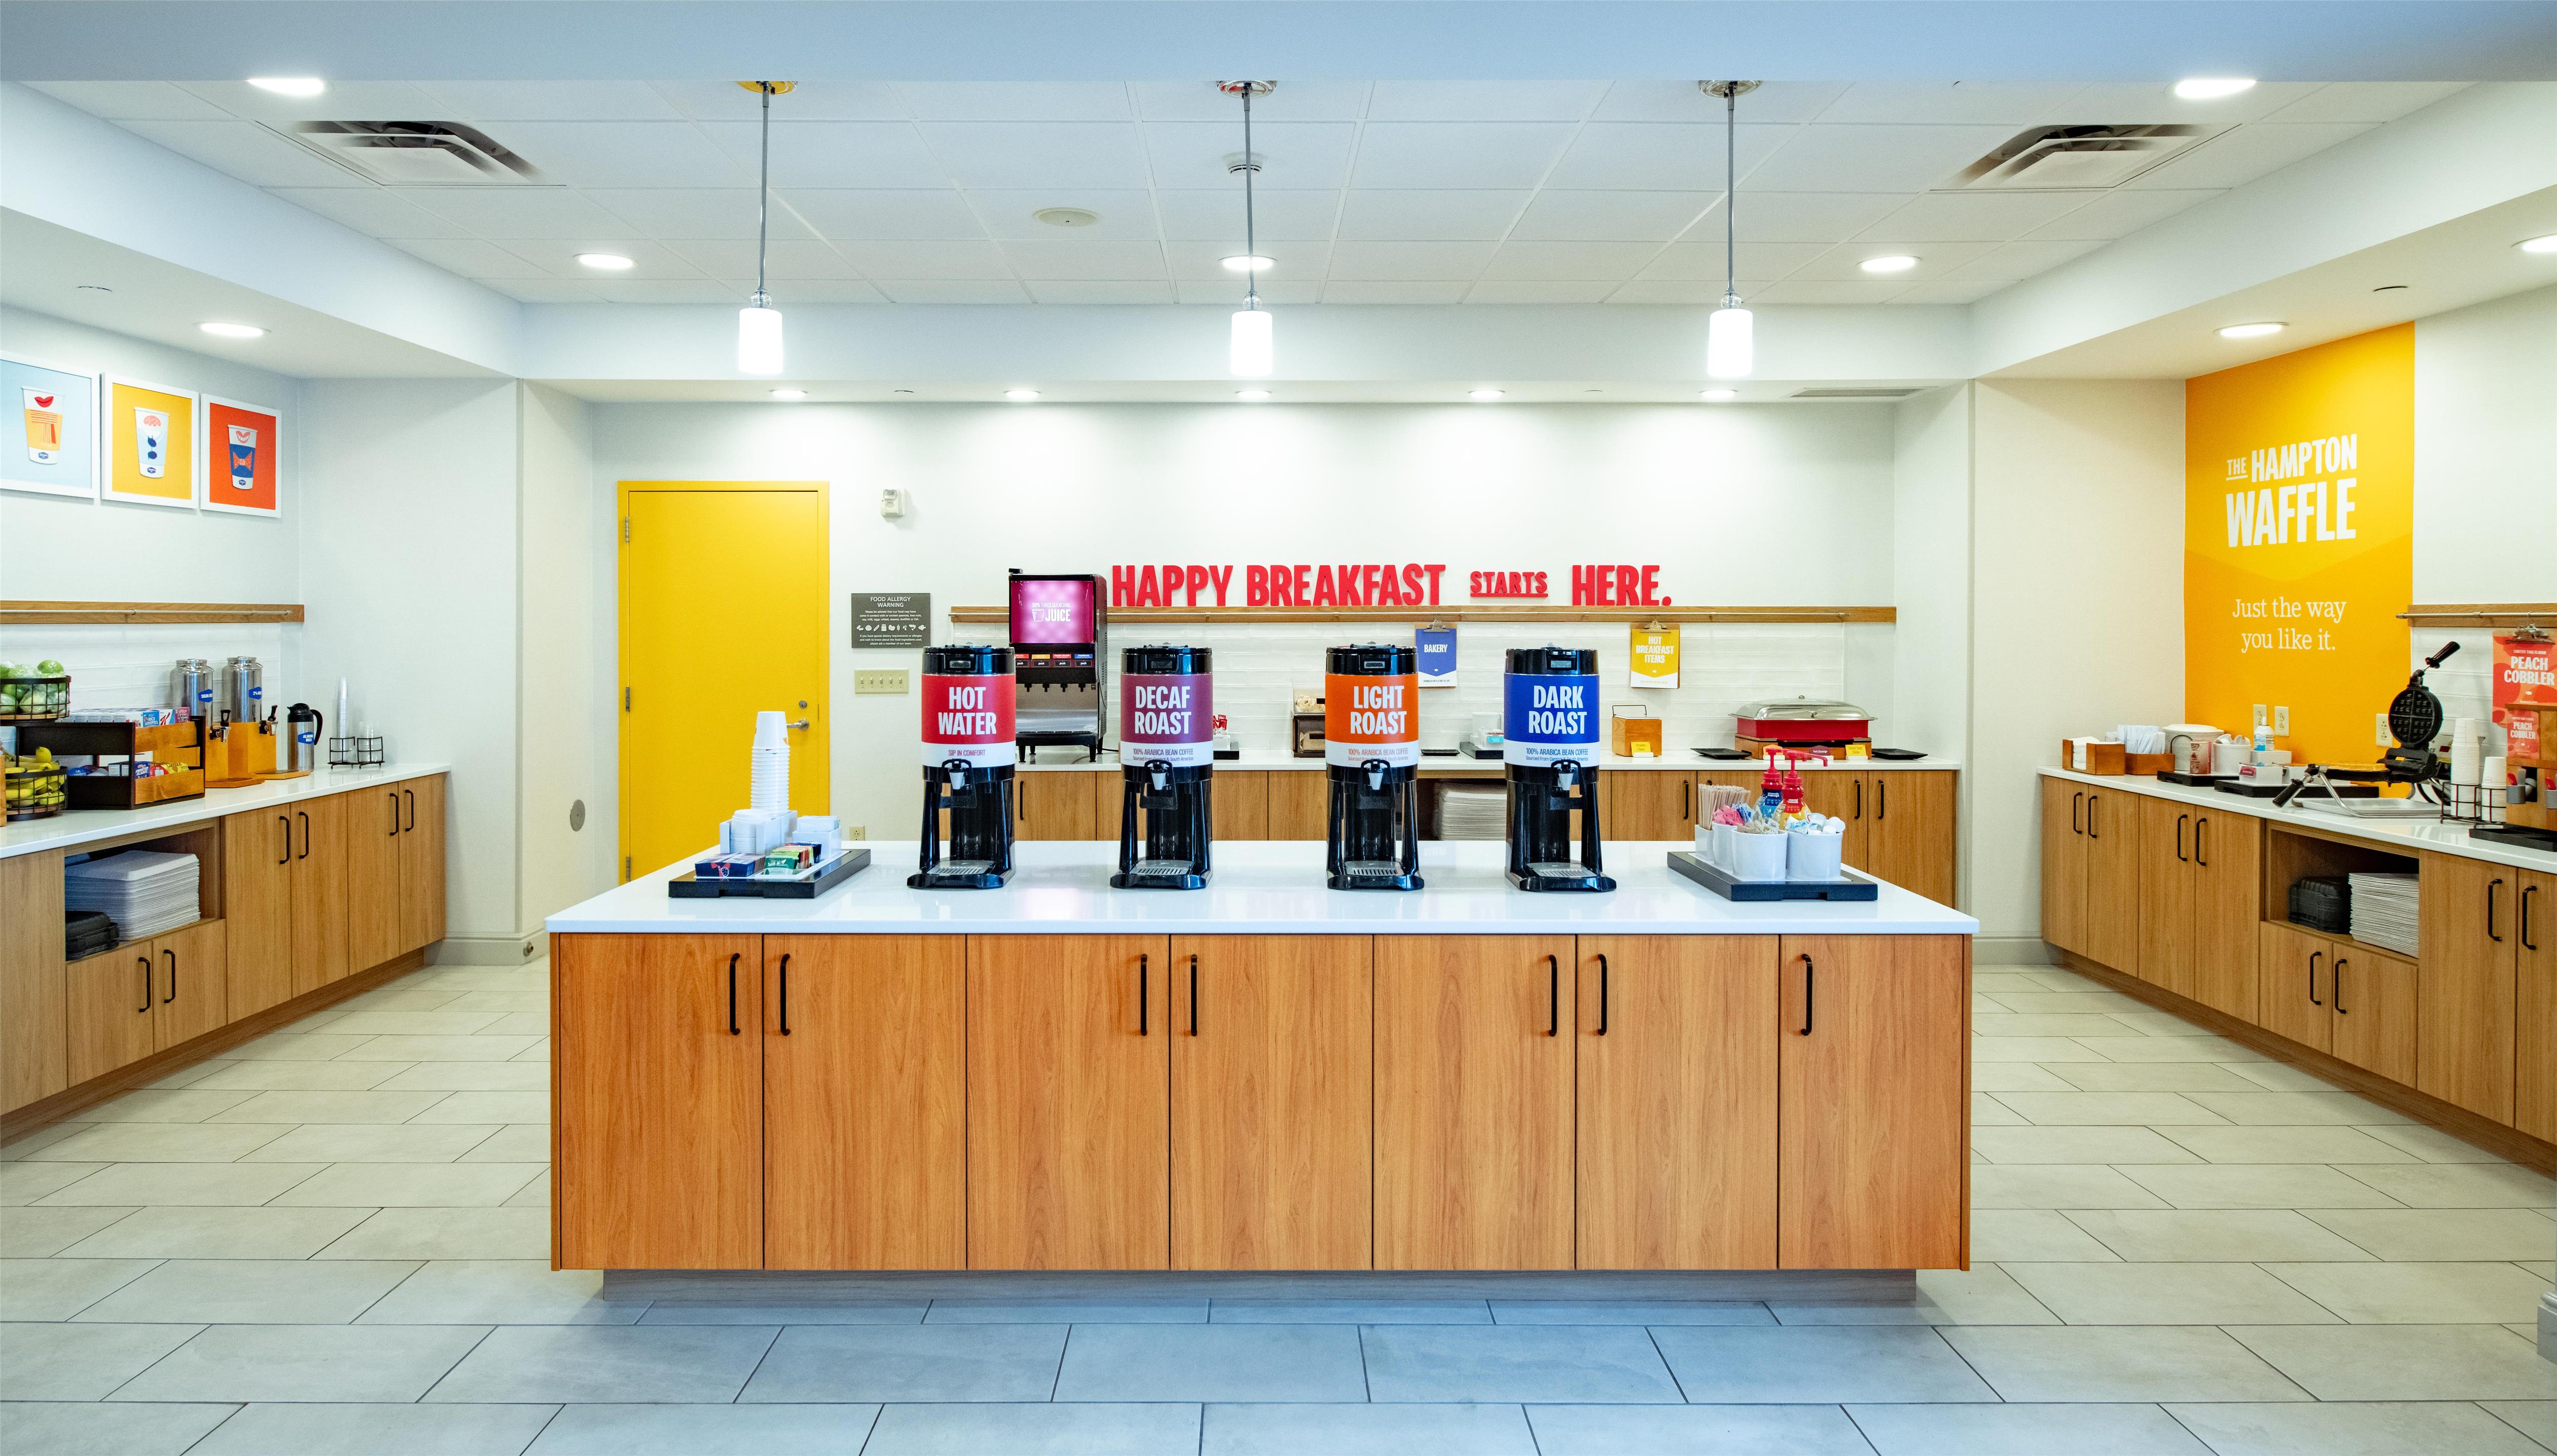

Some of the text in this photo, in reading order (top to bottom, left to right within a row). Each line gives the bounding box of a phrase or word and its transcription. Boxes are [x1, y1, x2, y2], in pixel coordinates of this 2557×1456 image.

[2226, 433, 2357, 483] THE HAMPTON
[2226, 477, 2357, 548] WAFFLE
[1112, 563, 1672, 607] HAPPY BREAKFAST STARTS HERE.
[1045, 609, 1071, 622] JUICE
[2232, 596, 2347, 624] Just the way
[1424, 644, 1448, 653] BAKERY
[1636, 645, 1675, 654] BREAKFAST
[1648, 636, 1662, 645] HOT
[2241, 628, 2336, 653] you like it.
[1644, 654, 1666, 663] ITEMS
[2510, 656, 2548, 671] PEACH
[2504, 669, 2554, 686] COBBLER
[949, 687, 986, 709] HOT
[1136, 686, 1190, 709] DECAF
[1354, 686, 1404, 709] LIGHT
[1534, 685, 1584, 708] DARK
[938, 712, 997, 735] WATER
[1135, 711, 1192, 735] ROAST
[1351, 711, 1407, 735] ROAST
[1529, 711, 1587, 735] ROAST
[2513, 721, 2532, 731] PEACH
[2510, 730, 2536, 740] COBBLER
